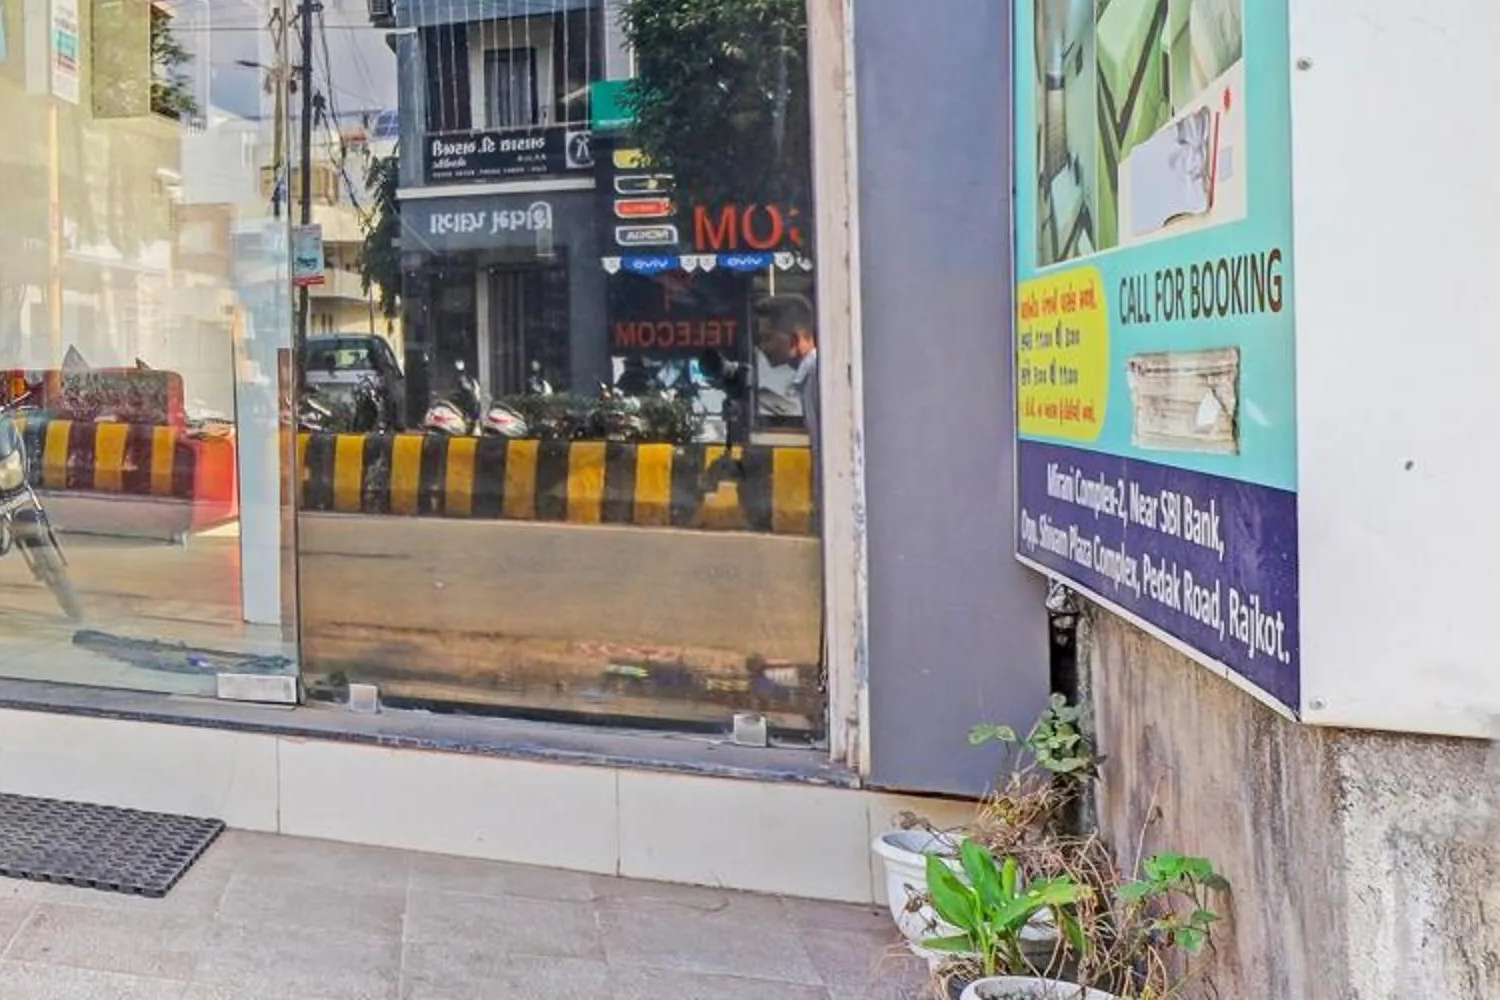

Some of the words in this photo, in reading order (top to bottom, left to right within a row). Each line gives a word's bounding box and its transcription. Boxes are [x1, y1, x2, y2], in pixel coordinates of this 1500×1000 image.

[1119, 272, 1151, 325] CALL
[1155, 267, 1186, 322] FOR
[1190, 247, 1283, 319] BOOKING
[1047, 463, 1075, 505] Mirani
[1129, 481, 1160, 530] Near
[1160, 489, 1181, 537] SBI
[1184, 495, 1225, 561] Bank,
[1039, 513, 1068, 557] Shivam
[1069, 524, 1093, 569] Plaza
[1094, 534, 1141, 600] Complex,
[1142, 553, 1181, 612] Pedak
[1183, 569, 1225, 642] Road,
[1228, 587, 1291, 665] Rajkot.
